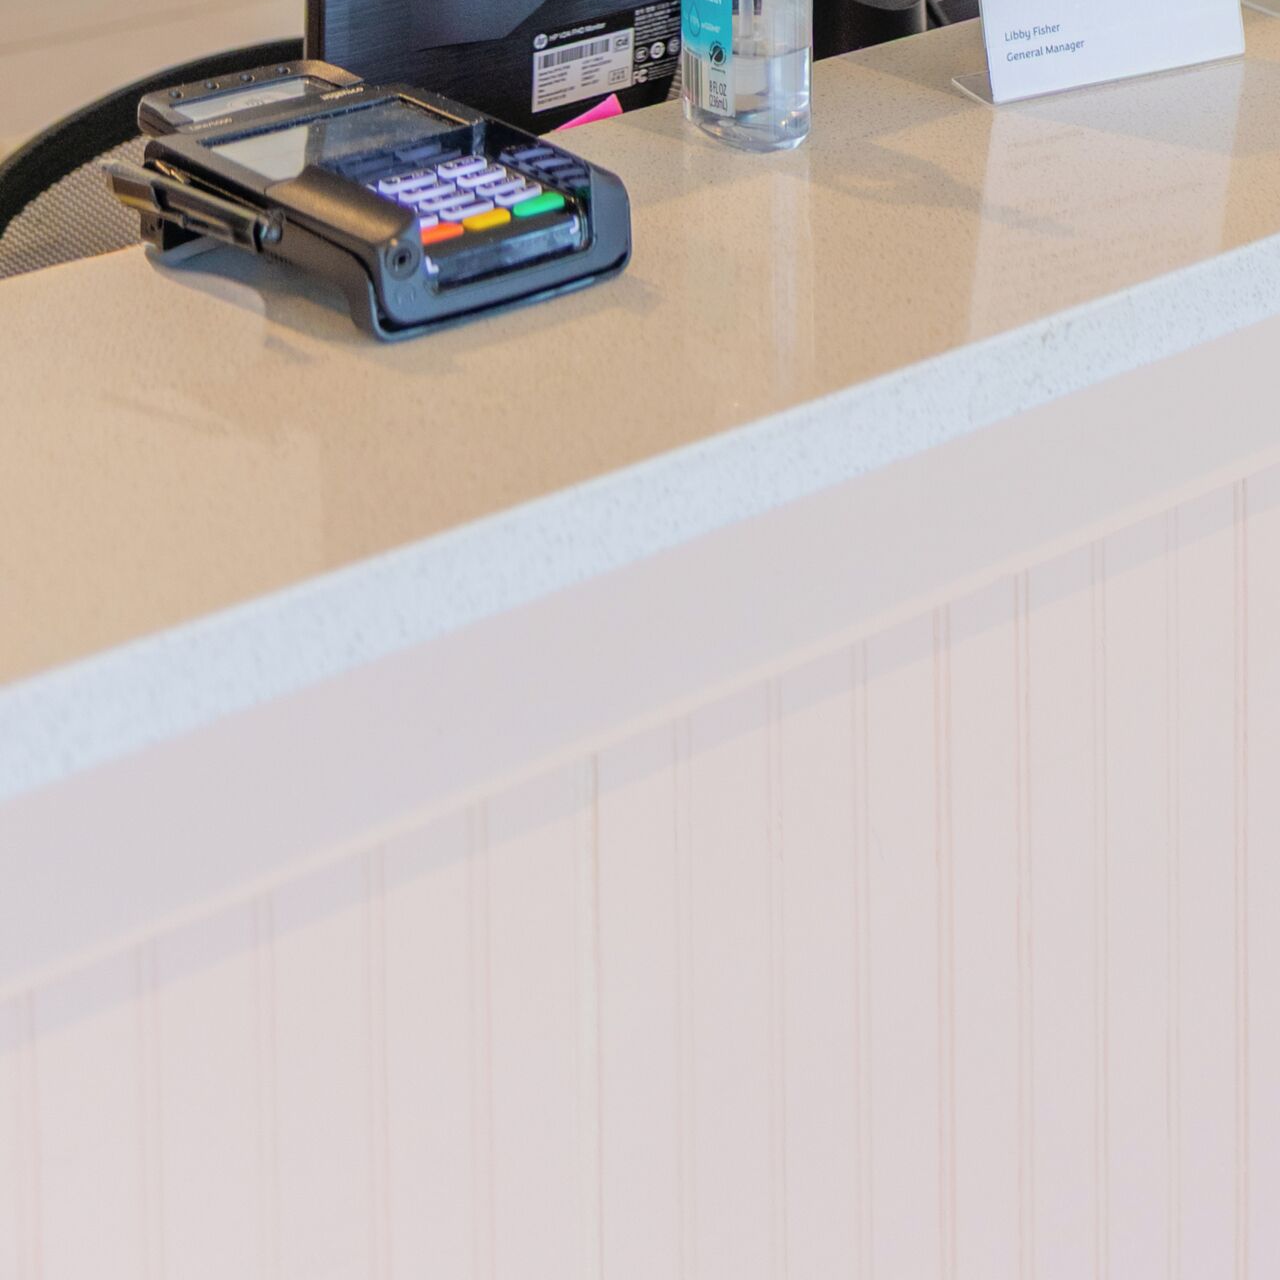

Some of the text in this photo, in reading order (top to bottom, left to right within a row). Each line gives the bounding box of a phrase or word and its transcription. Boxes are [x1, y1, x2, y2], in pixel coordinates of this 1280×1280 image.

[1004, 24, 1060, 42] Libby Fisher
[1006, 40, 1084, 62] General Manager
[713, 82, 718, 94] FL
[720, 82, 727, 96] OZ
